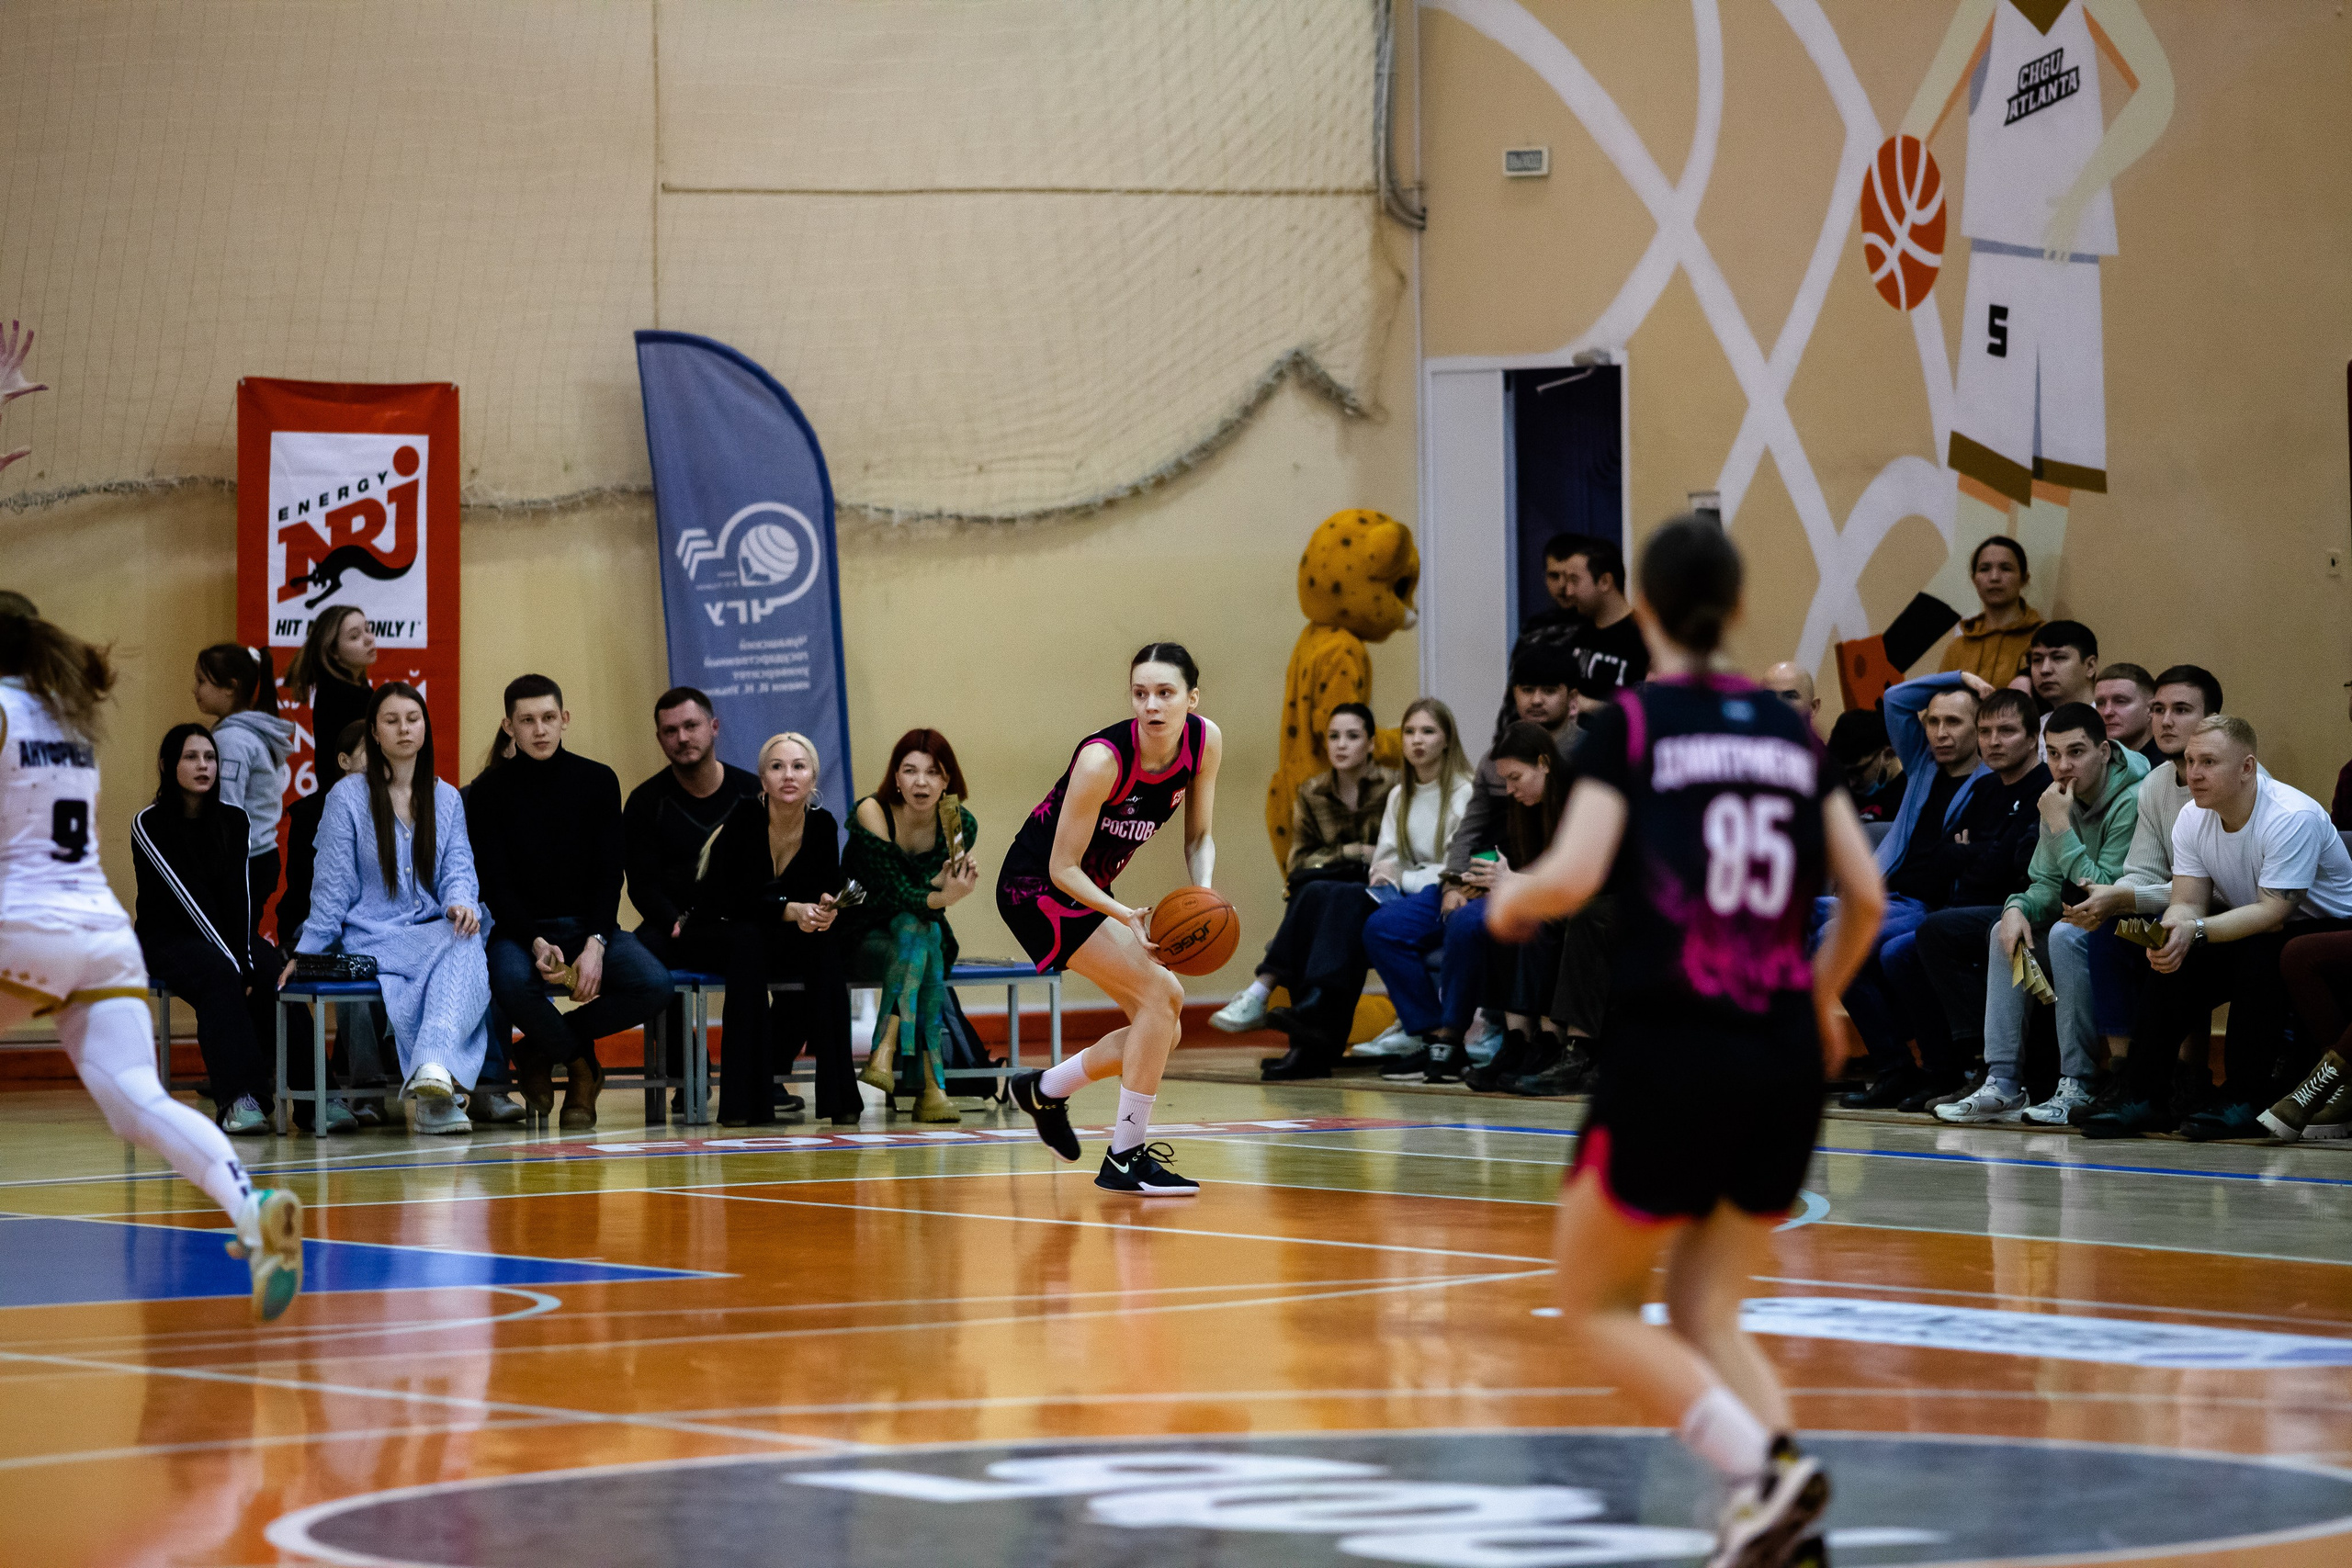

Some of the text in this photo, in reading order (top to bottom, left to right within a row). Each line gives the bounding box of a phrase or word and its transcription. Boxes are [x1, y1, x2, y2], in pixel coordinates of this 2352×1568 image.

[2007, 70, 2080, 121] ATLANTA
[2018, 51, 2063, 91] CHGU
[1986, 303, 2009, 358] 5
[277, 470, 389, 522] ENERGY
[275, 618, 303, 637] HIT
[51, 798, 89, 863] 9
[1702, 791, 1796, 919] 85
[1163, 919, 1212, 956] JÖGEL
